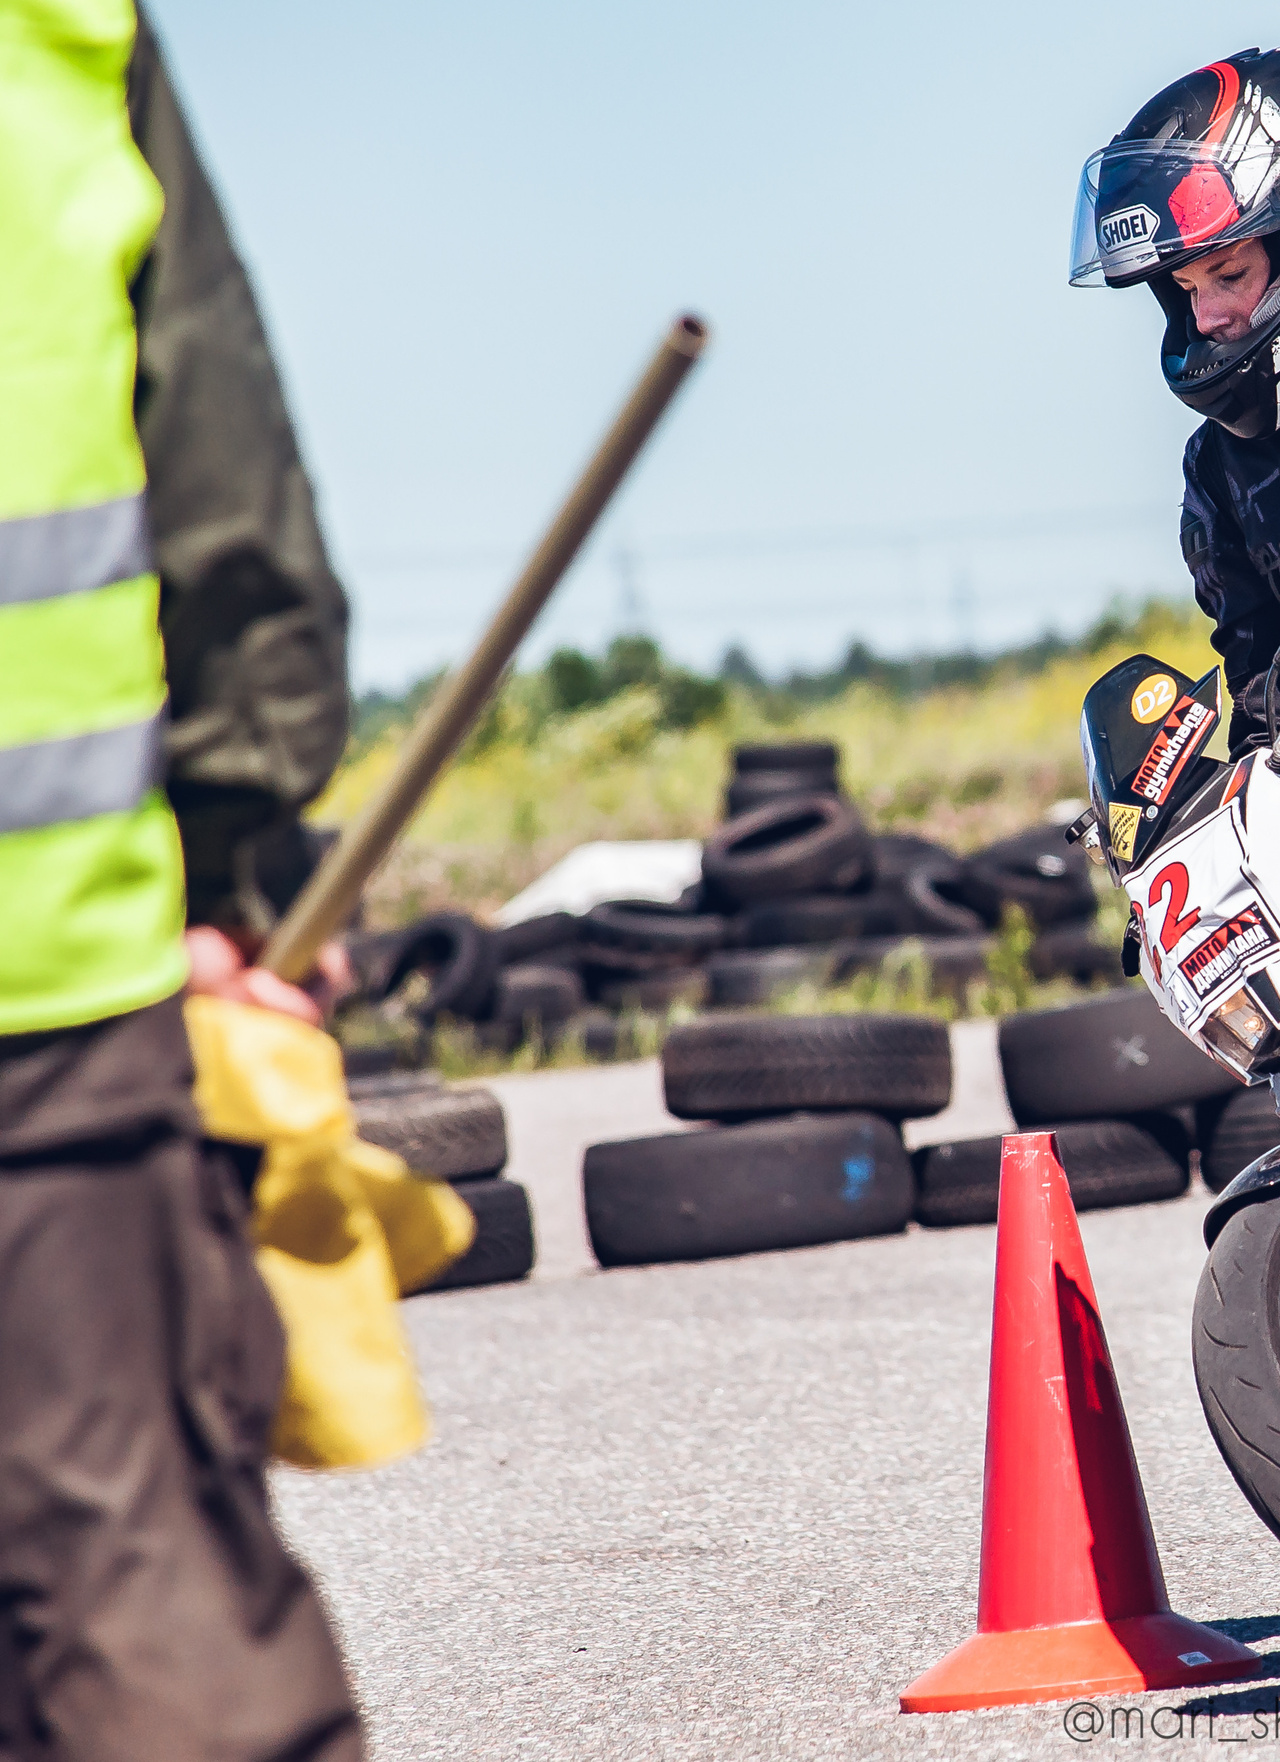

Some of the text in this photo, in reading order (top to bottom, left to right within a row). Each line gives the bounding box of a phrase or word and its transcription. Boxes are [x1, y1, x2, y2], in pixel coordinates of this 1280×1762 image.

[1102, 212, 1148, 249] SHOEI
[1134, 680, 1173, 719] D2
[1143, 702, 1206, 802] gymkhana
[1192, 924, 1270, 996] ДЖИМХАНА
